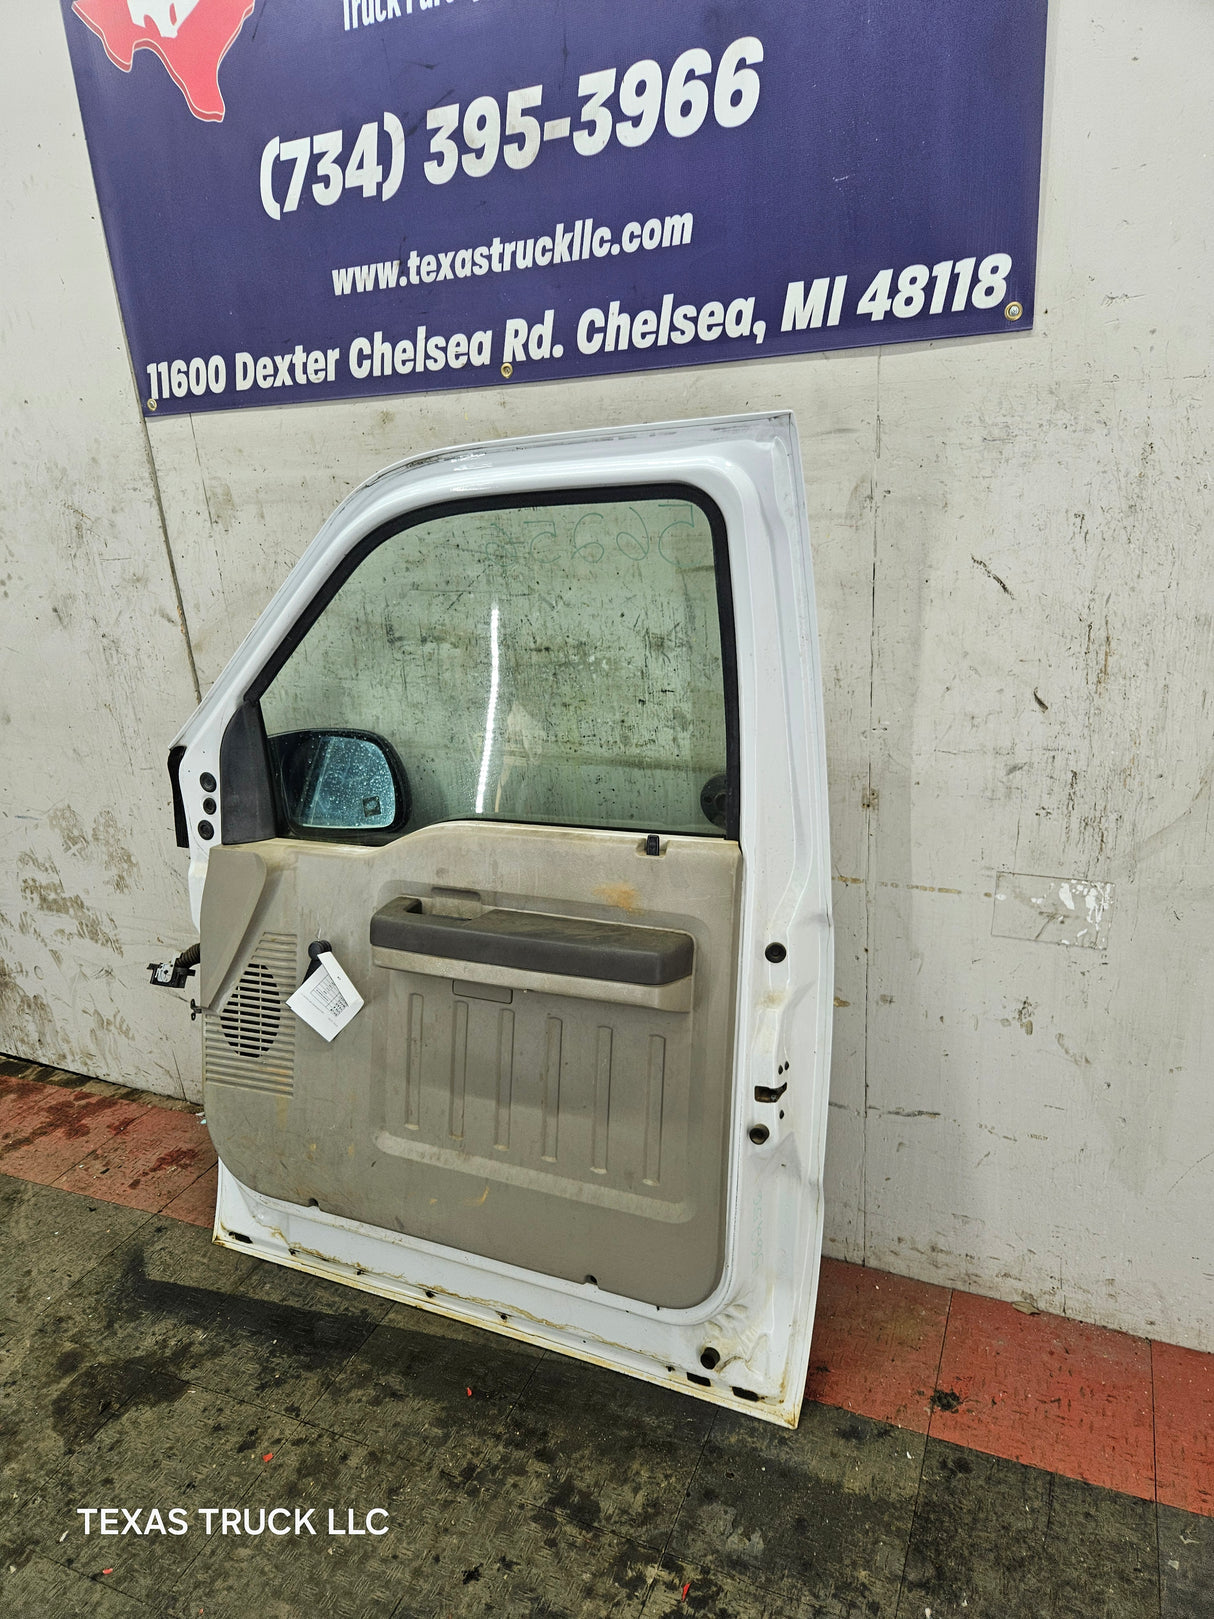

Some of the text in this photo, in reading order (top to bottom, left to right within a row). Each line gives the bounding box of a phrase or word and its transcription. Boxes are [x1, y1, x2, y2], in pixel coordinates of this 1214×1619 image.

[259, 37, 764, 220] (734) 395-3966
[146, 253, 1013, 400] 11600 Dexter Chelsea Rd. Chelsea, MI 48118
[331, 212, 694, 296] www.texastruckllc.com
